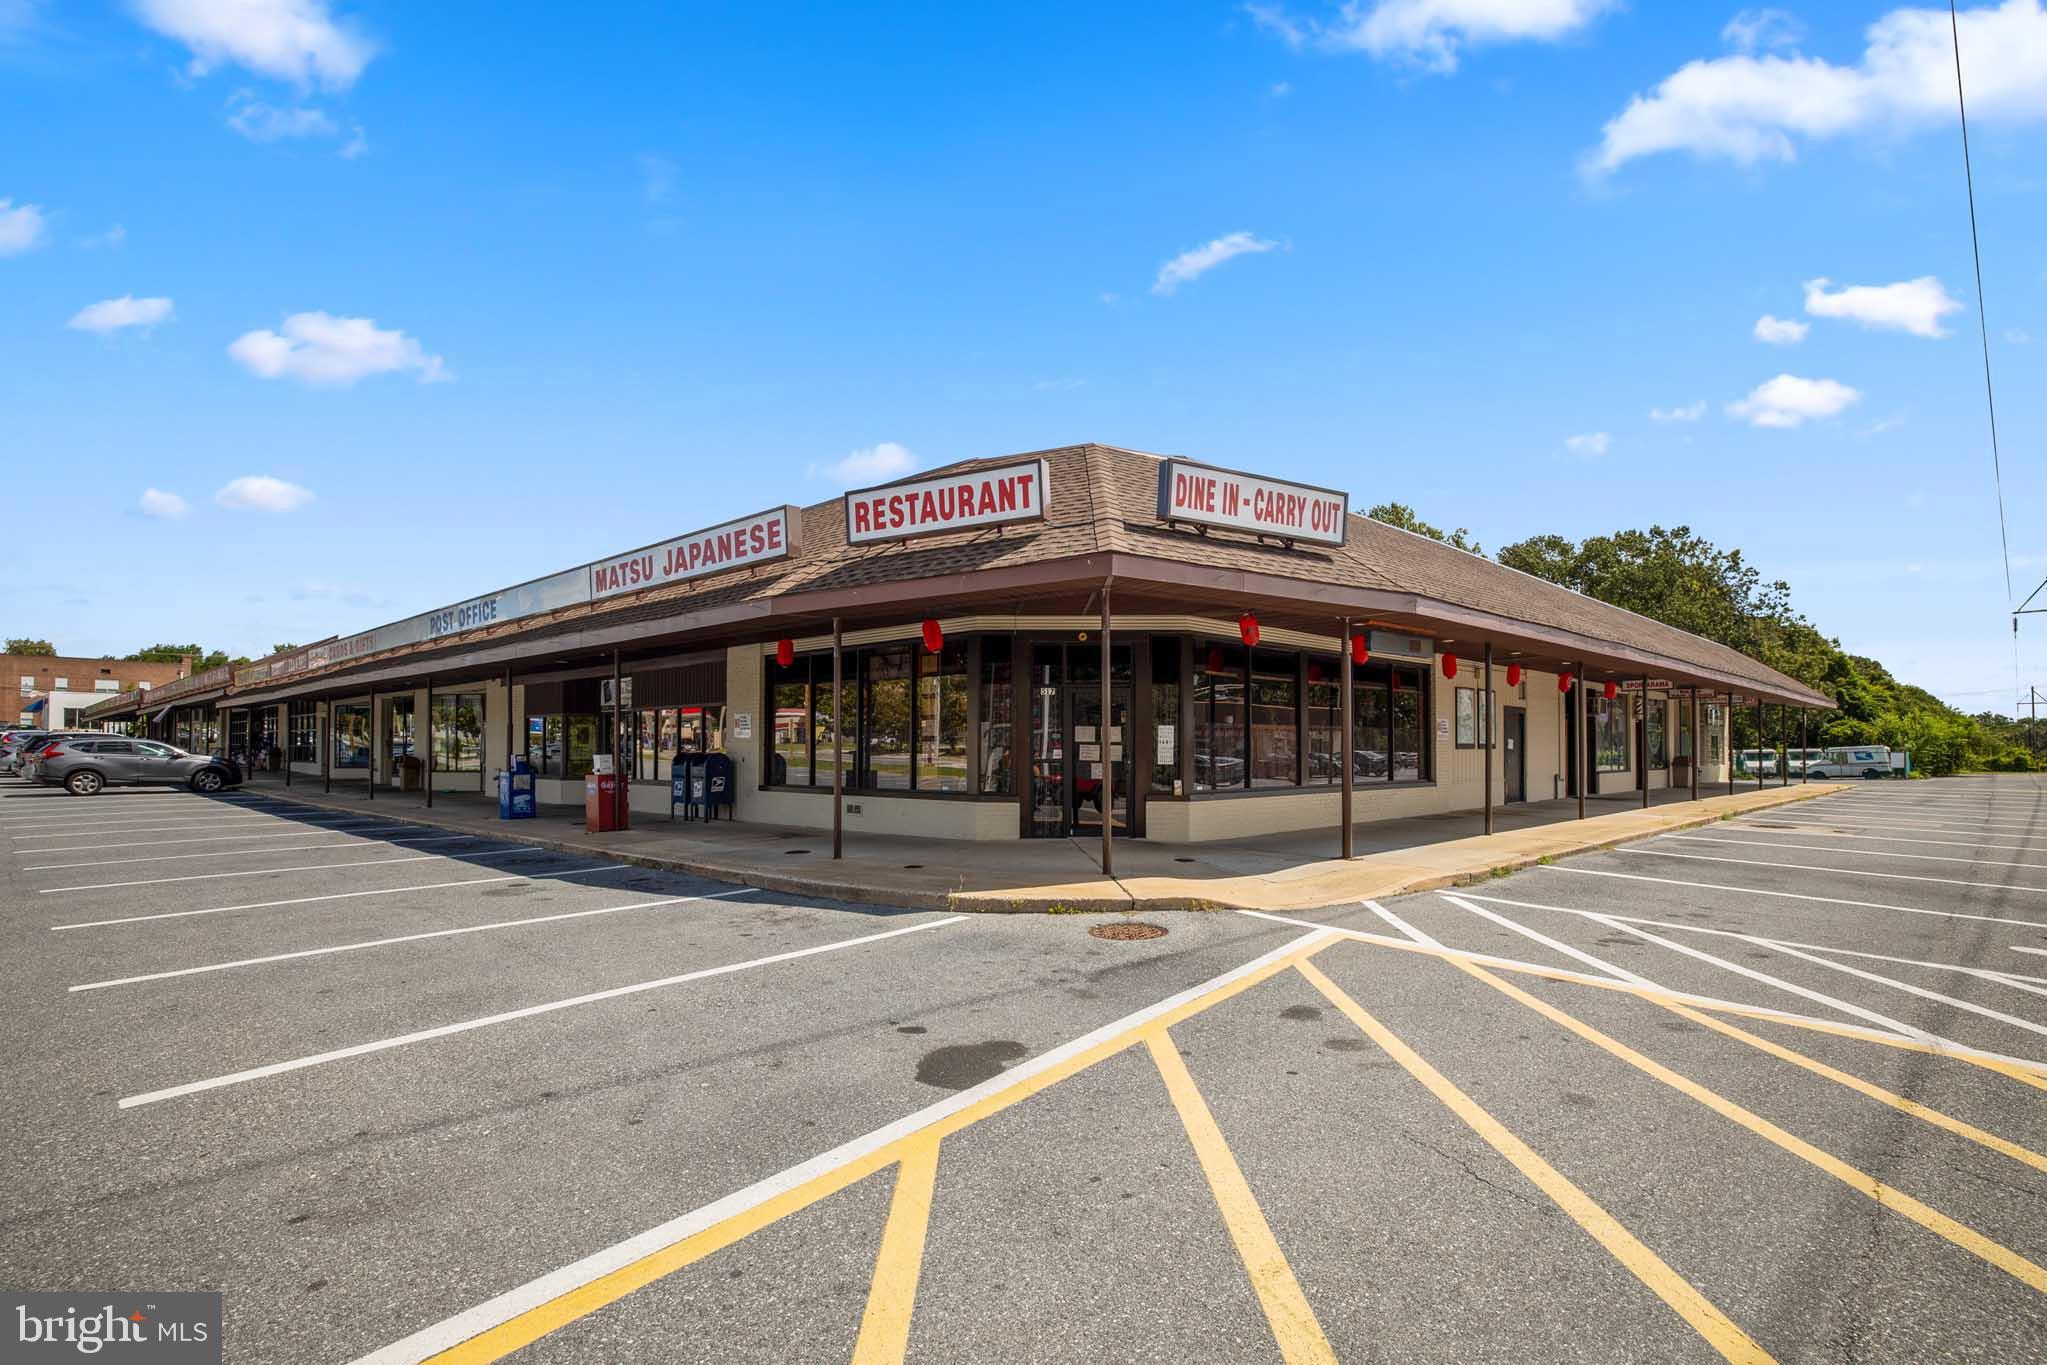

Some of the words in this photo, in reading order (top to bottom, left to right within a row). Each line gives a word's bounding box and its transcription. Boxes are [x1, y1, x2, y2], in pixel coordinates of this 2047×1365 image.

[855, 474, 1033, 533] RESTAURANT
[1175, 473, 1217, 513] DINE
[1311, 499, 1340, 534] OUT
[595, 555, 654, 593] MATSU
[663, 519, 782, 577] JAPANESE
[430, 611, 454, 634] POST
[458, 599, 497, 627] OFFICE
